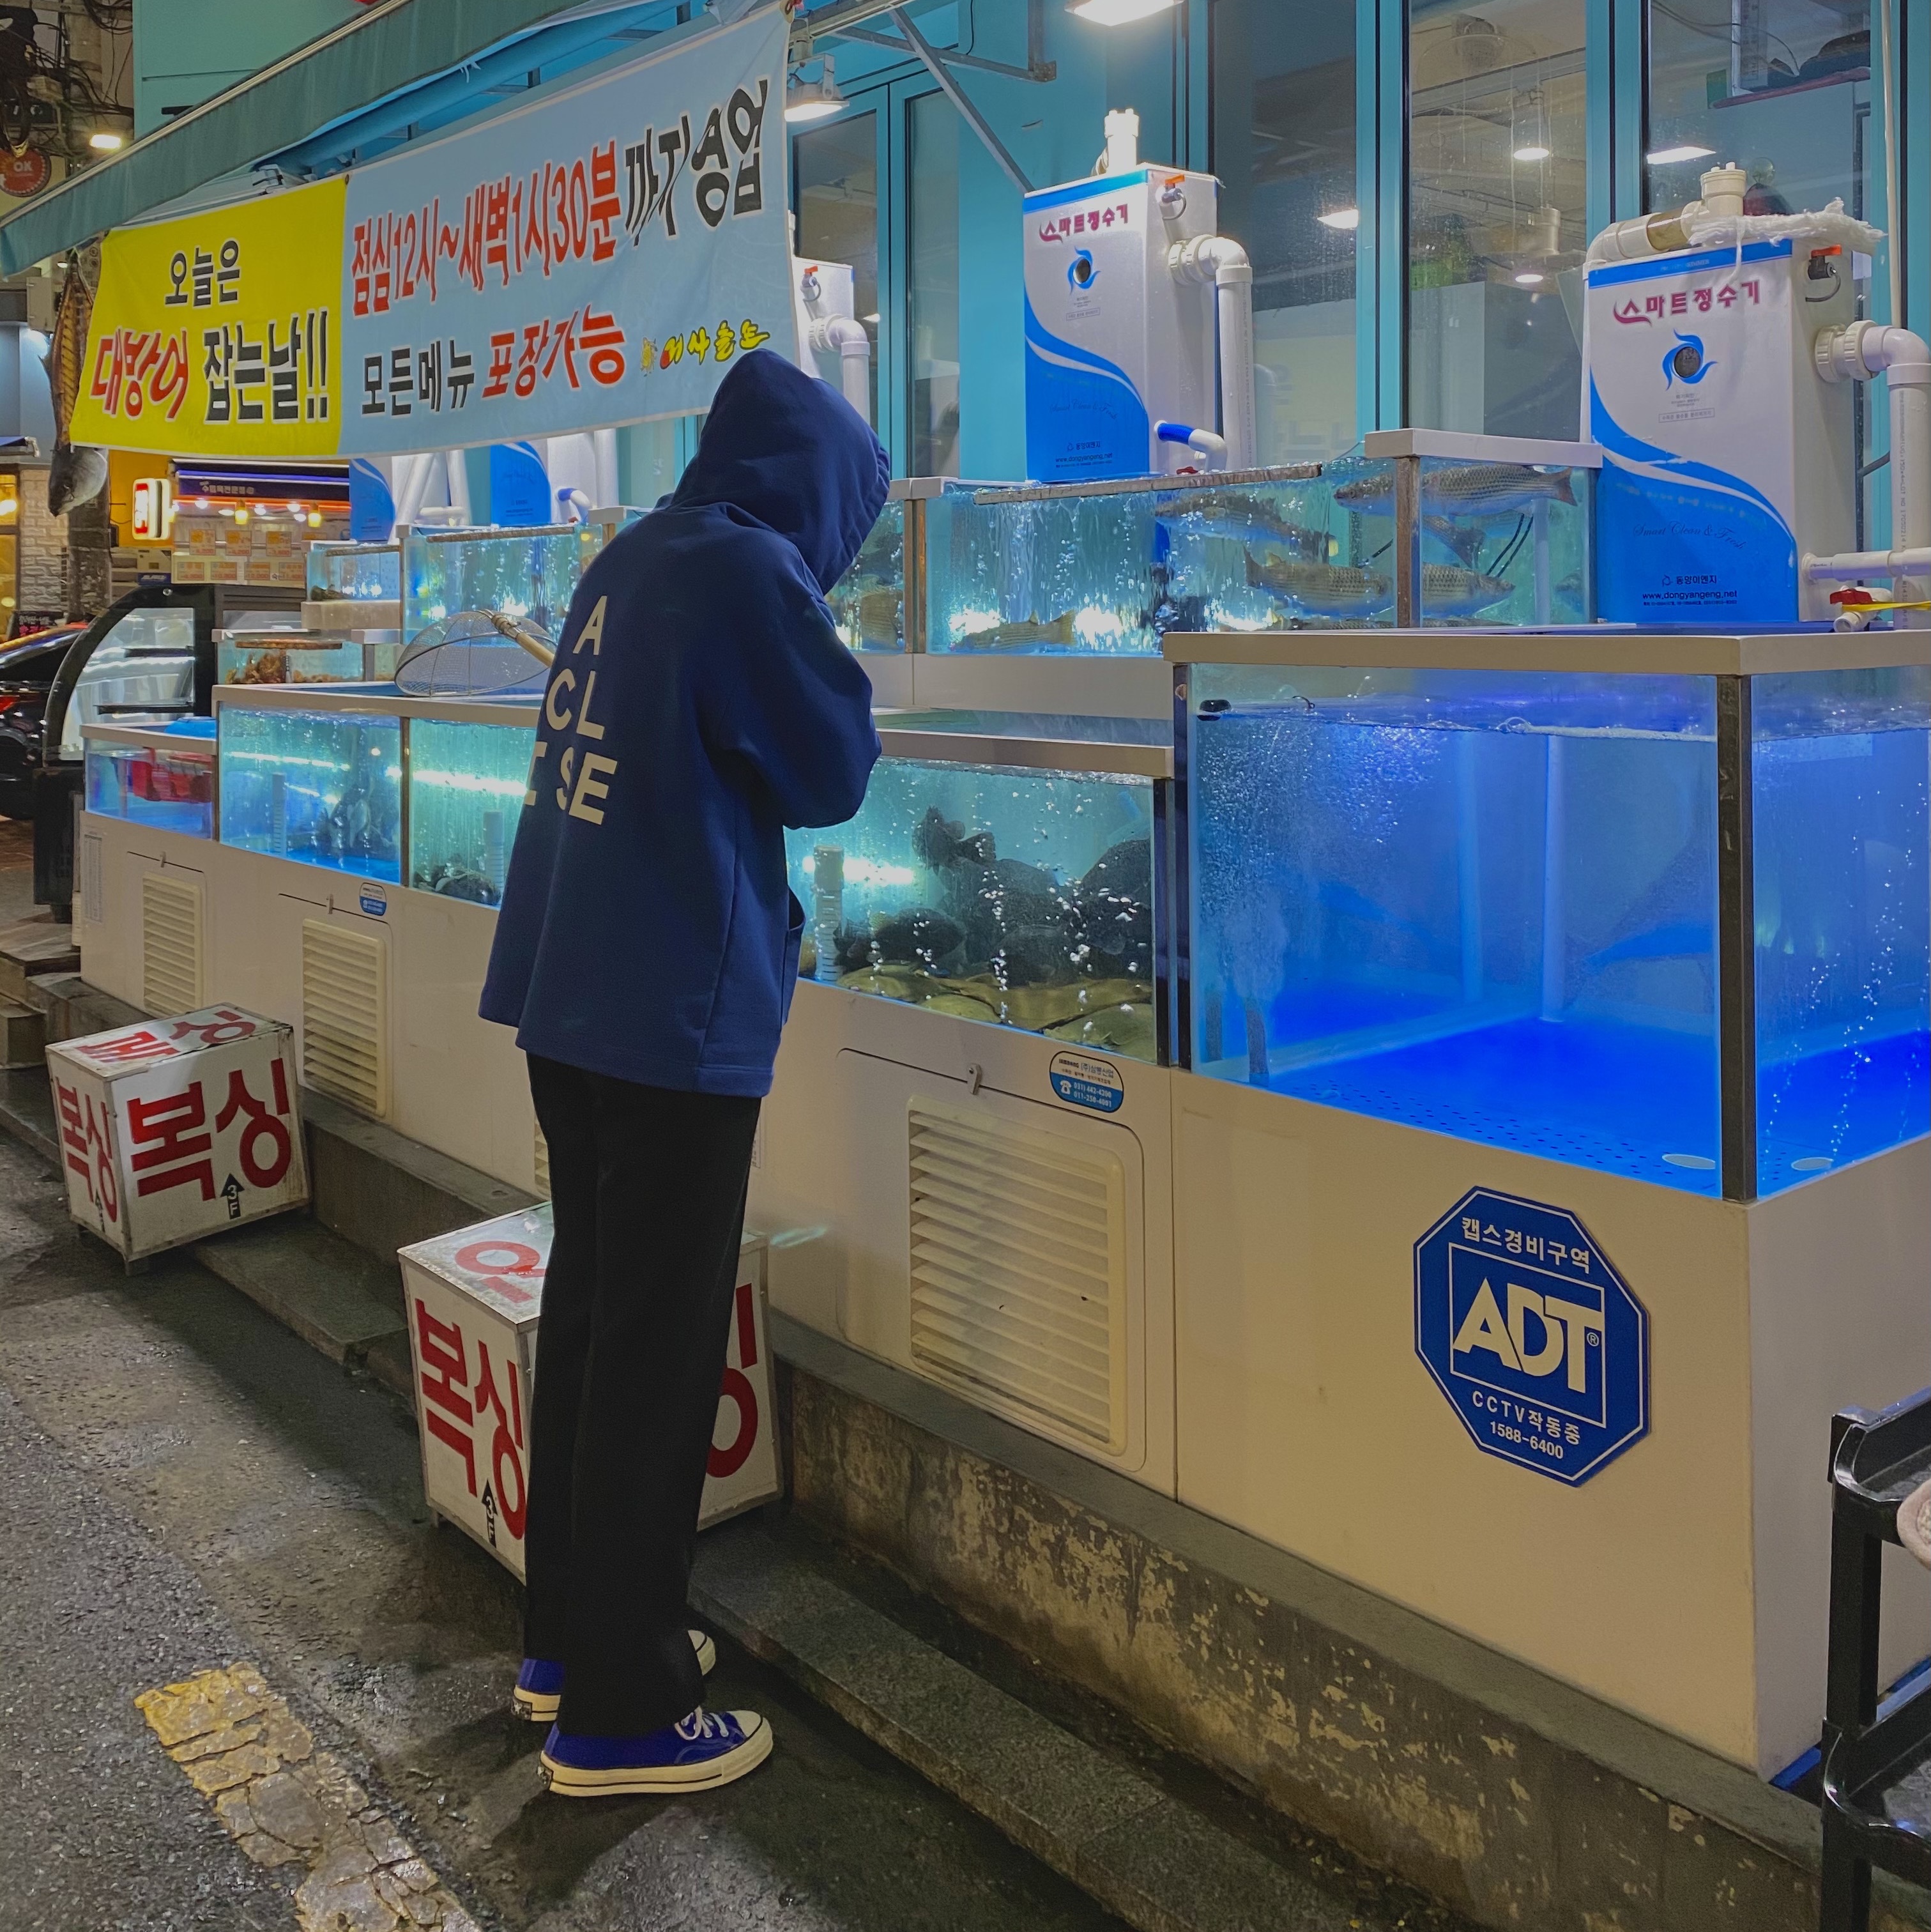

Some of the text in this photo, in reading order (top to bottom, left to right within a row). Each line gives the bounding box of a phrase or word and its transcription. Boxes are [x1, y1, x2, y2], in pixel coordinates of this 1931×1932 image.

[13, 161, 33, 172] OK
[1039, 203, 1129, 243] 스마트정수기
[164, 240, 241, 307] 오늘은
[1612, 279, 1760, 327] 스마트정수기
[90, 309, 329, 422] 대방어 잡는날!!
[482, 303, 626, 399] 포장가능
[1633, 521, 1667, 537] Smart
[1668, 520, 1701, 536] Clean
[1642, 590, 1737, 601] www.dongyangeng.net
[573, 595, 607, 656] A
[126, 1057, 291, 1202] 복싱
[1461, 1216, 1590, 1274] 캡스경비구역
[1453, 1276, 1605, 1394] ADT
[415, 1298, 526, 1540] 복싱
[1490, 1420, 1564, 1460] 1588-6400
